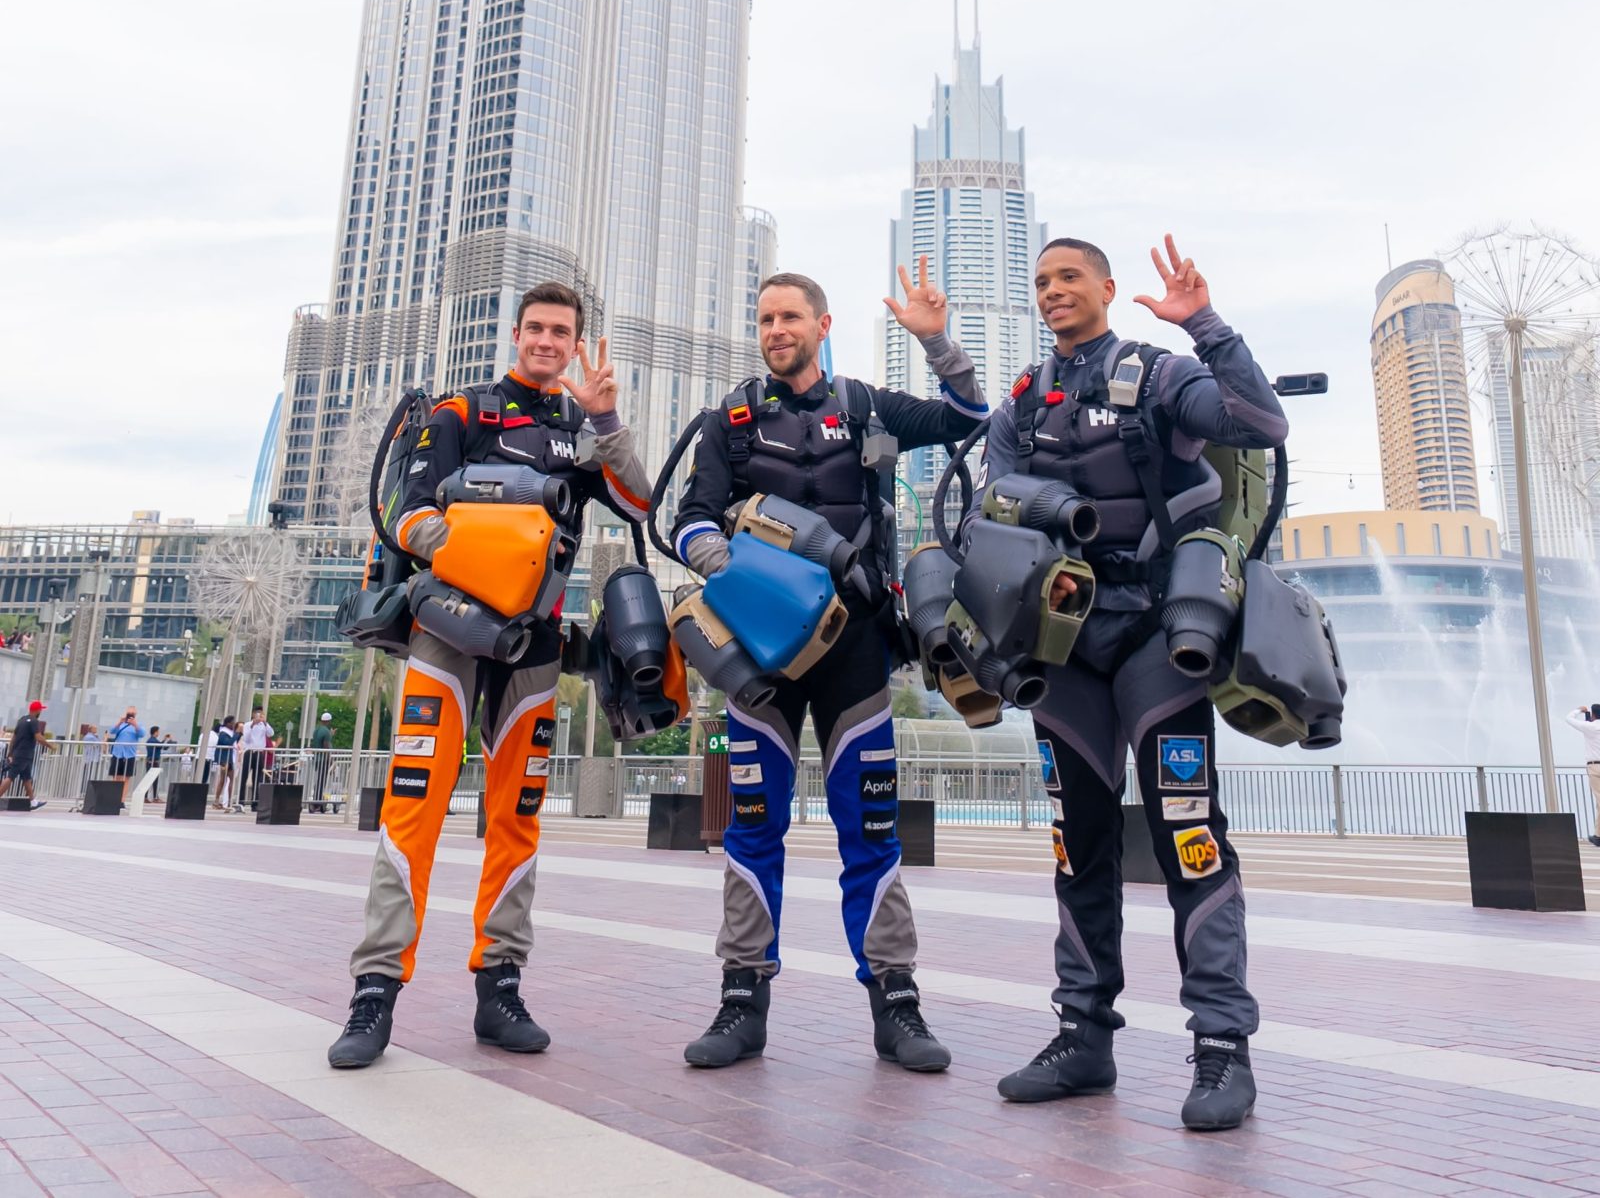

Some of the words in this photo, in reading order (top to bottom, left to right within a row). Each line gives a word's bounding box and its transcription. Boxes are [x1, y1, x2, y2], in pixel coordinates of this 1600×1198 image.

[550, 439, 574, 459] HH
[1168, 748, 1200, 762] ASL
[863, 779, 892, 795] Aprio
[1181, 841, 1216, 869] ups
